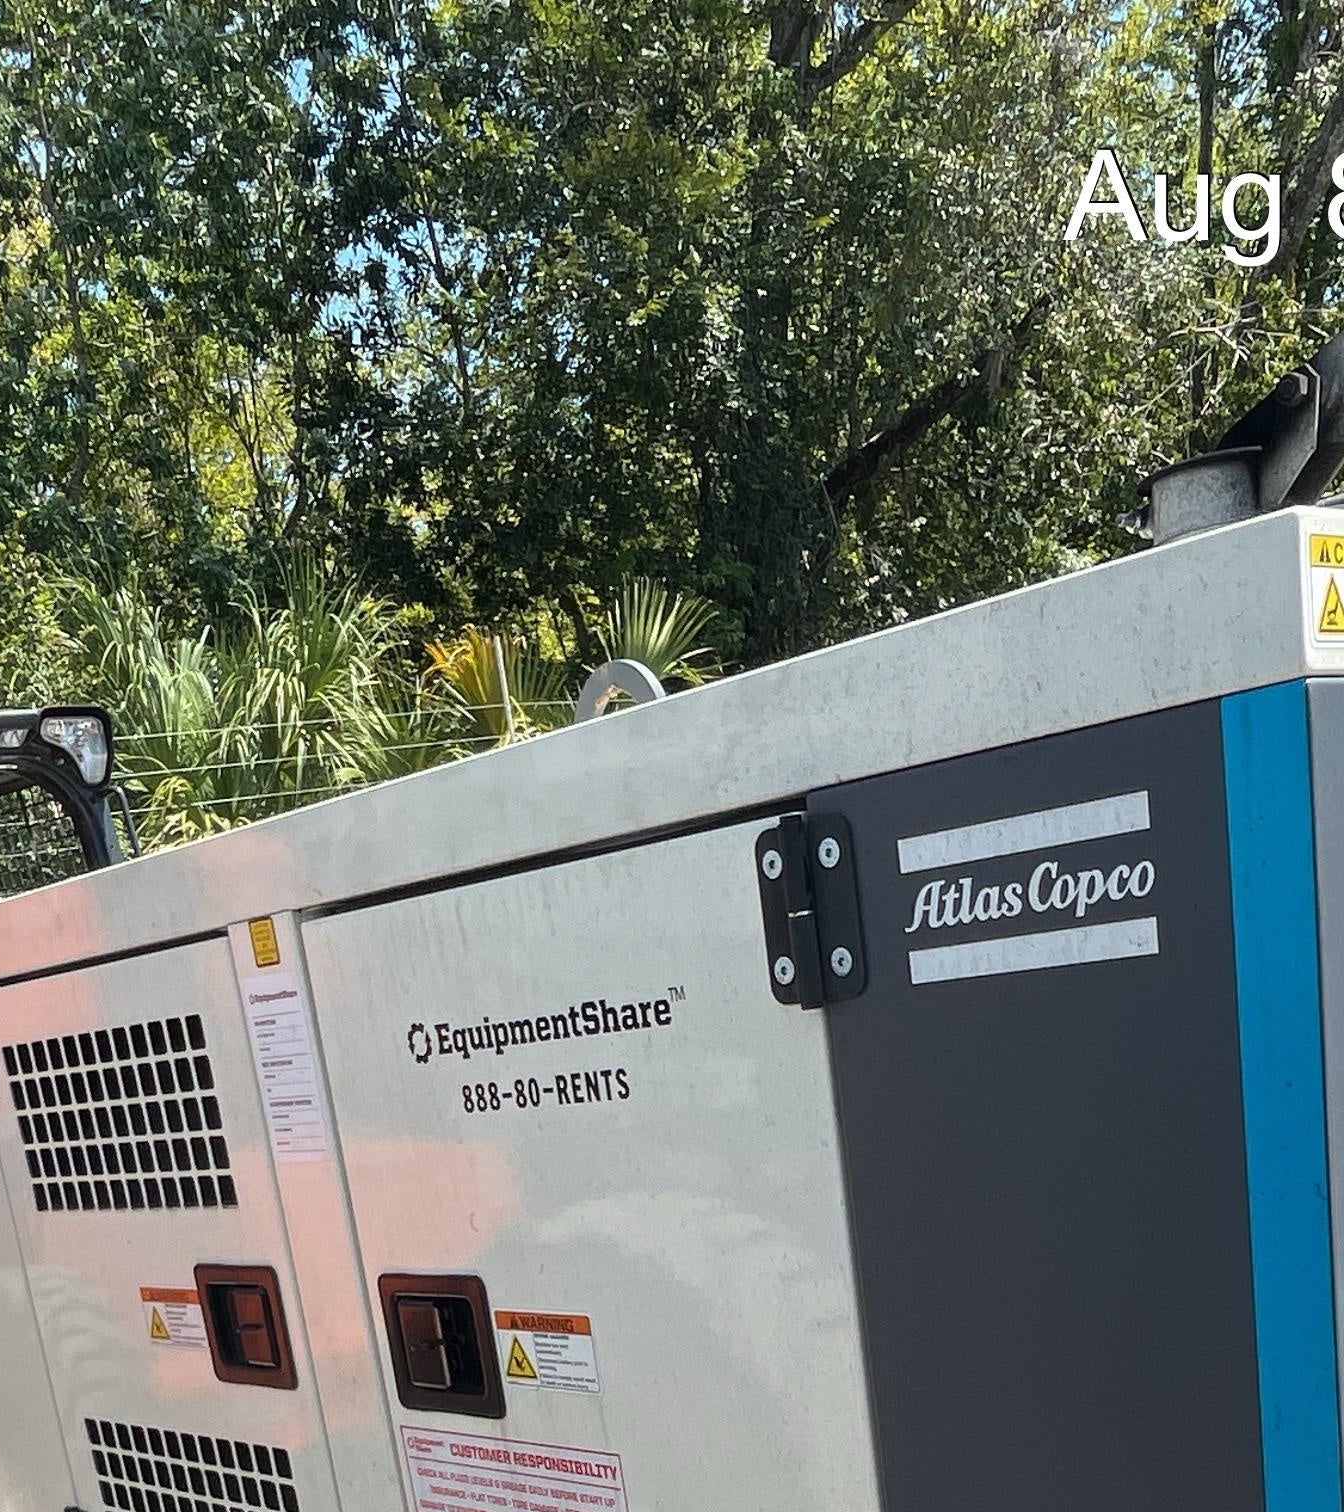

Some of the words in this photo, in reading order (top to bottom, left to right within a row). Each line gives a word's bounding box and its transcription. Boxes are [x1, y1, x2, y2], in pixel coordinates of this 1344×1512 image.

[904, 868, 1023, 934] Atlas
[1027, 859, 1157, 919] Copco
[434, 999, 672, 1061] EquipmentShare
[462, 1068, 630, 1113] 888-80-RENTS
[520, 1315, 575, 1332] WARNING
[450, 1443, 511, 1464] CUSTOMER
[513, 1452, 617, 1480] RESPONSIBILITY
